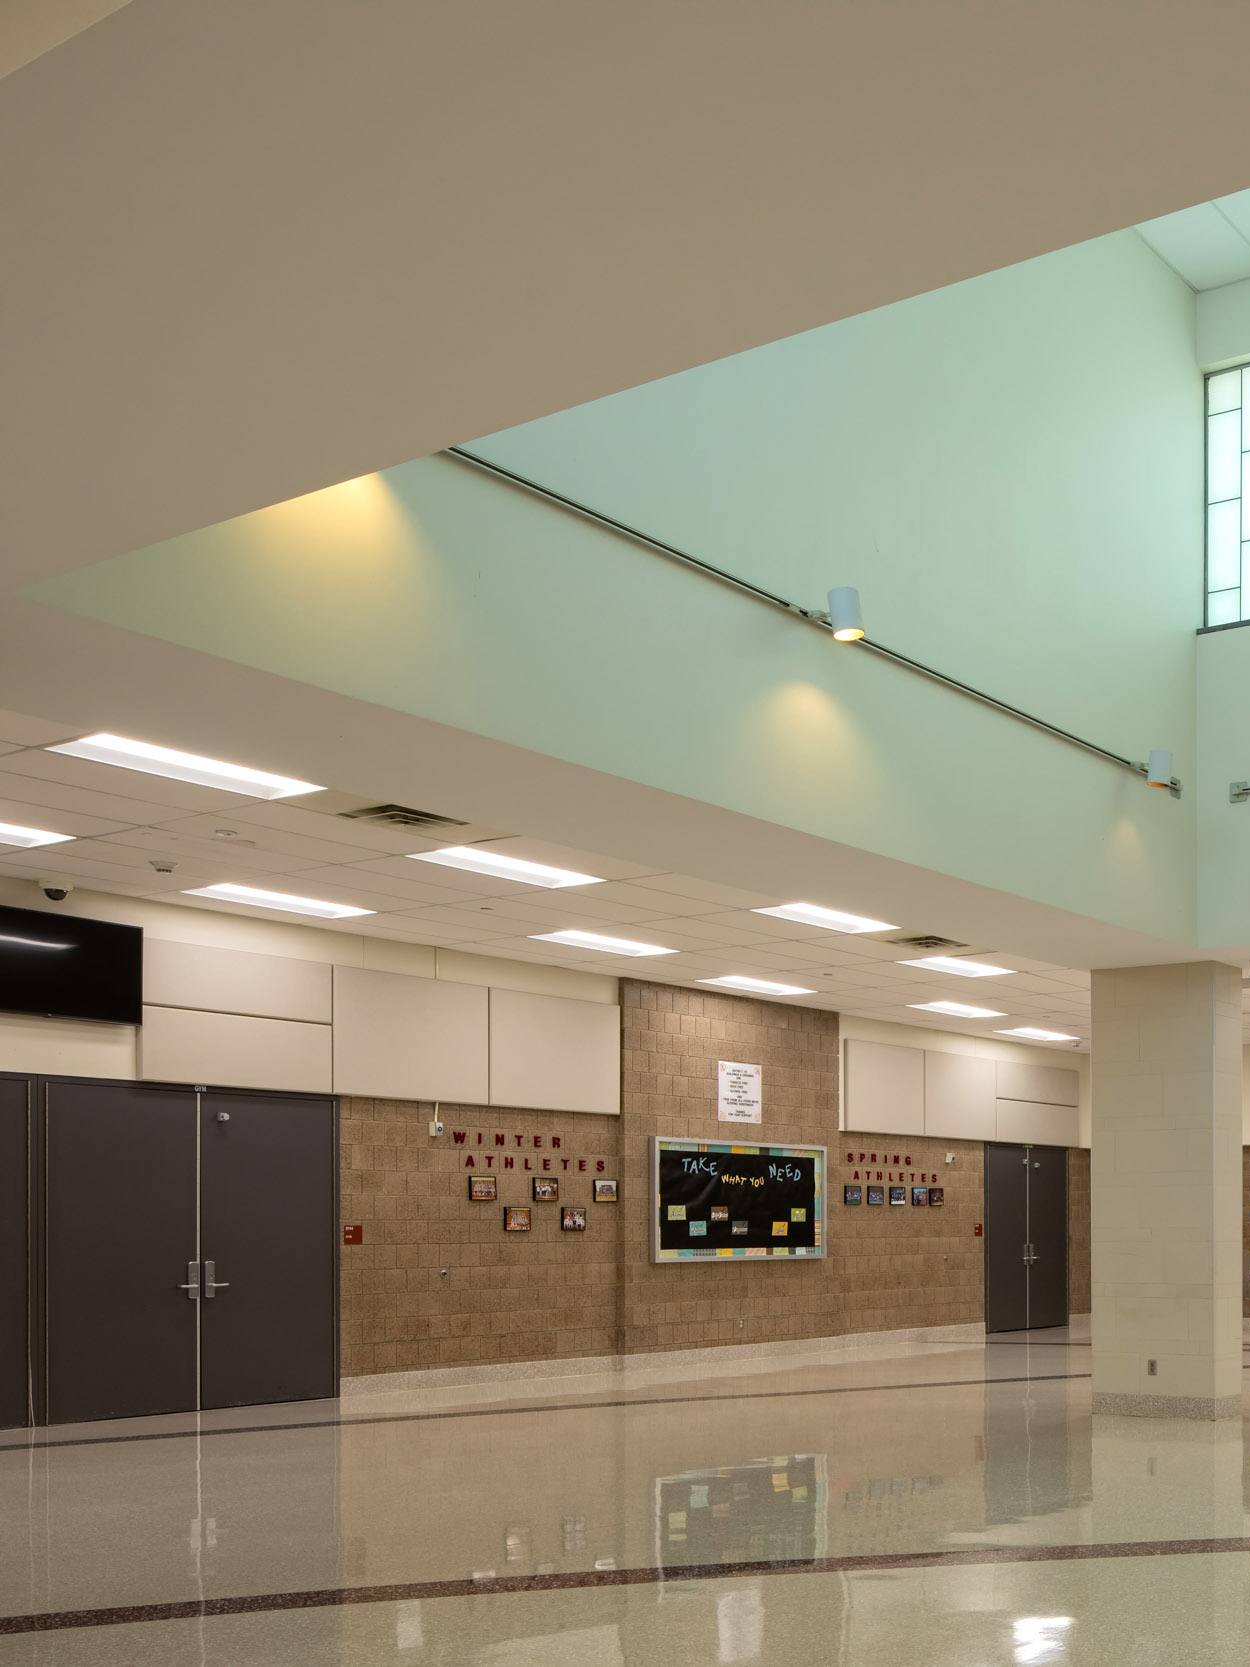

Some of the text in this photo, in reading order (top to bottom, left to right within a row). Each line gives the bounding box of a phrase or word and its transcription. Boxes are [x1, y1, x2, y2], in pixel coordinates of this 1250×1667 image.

[453, 1131, 561, 1148] WINTER
[465, 1155, 605, 1172] ATHLETES
[847, 1152, 912, 1166] SPRING
[682, 1157, 801, 1188] TAKE WHAT YOU NEED
[853, 1170, 938, 1183] ATHLETES
